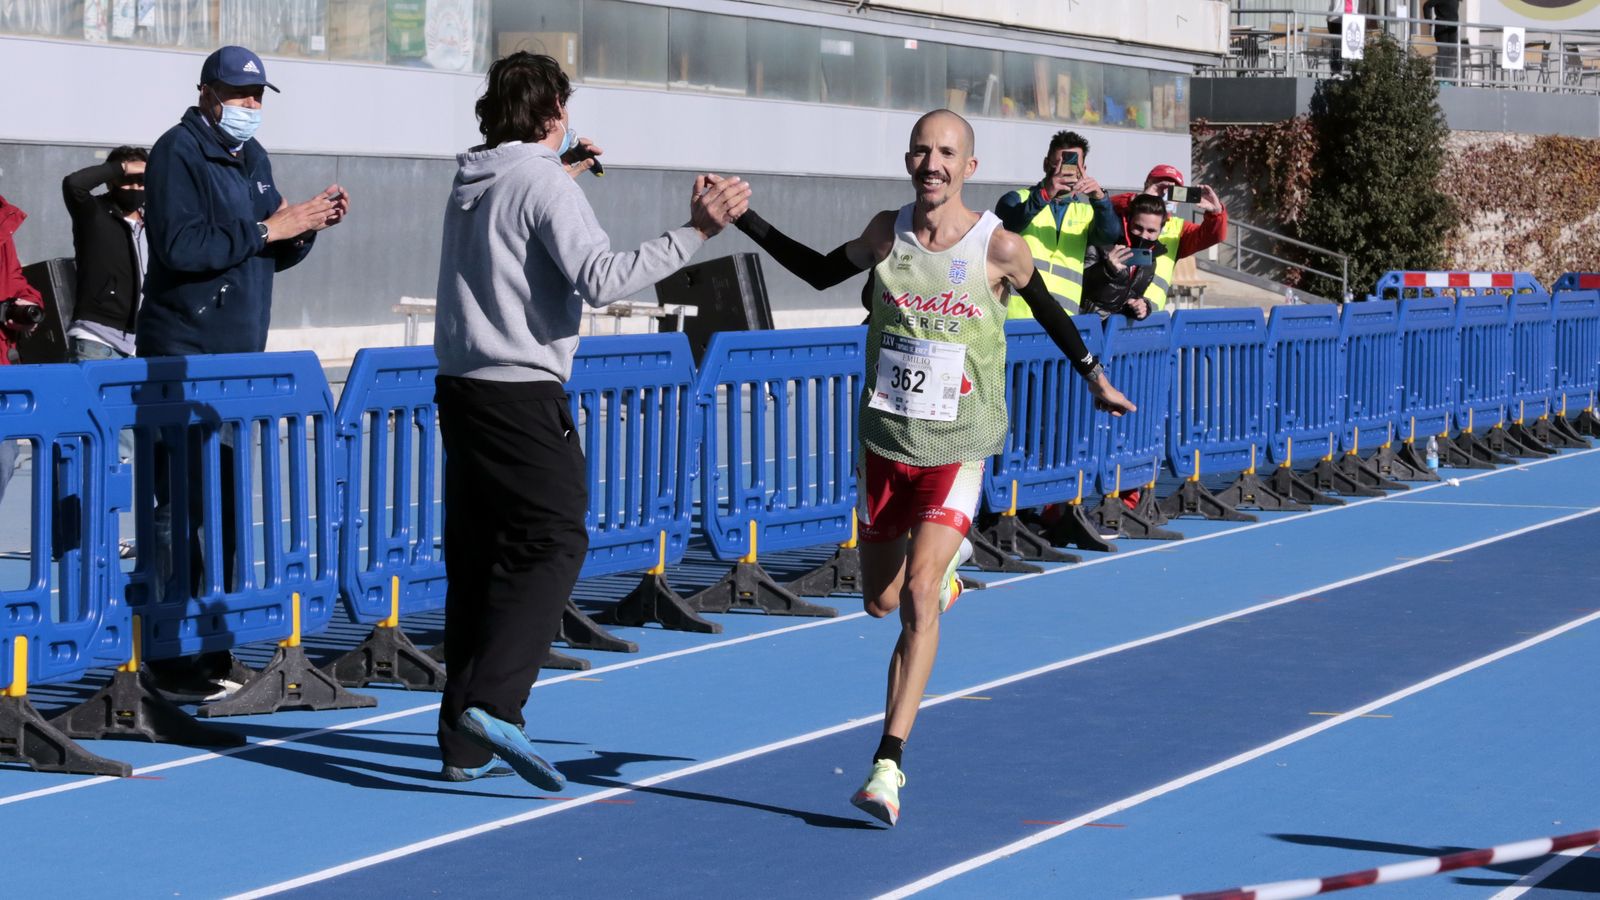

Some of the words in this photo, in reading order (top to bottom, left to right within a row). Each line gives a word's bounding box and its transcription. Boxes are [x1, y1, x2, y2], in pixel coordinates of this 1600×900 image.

[882, 290, 982, 318] maratón
[894, 312, 960, 333] JEREZ
[902, 354, 931, 366] EMILIO
[890, 365, 926, 394] 362
